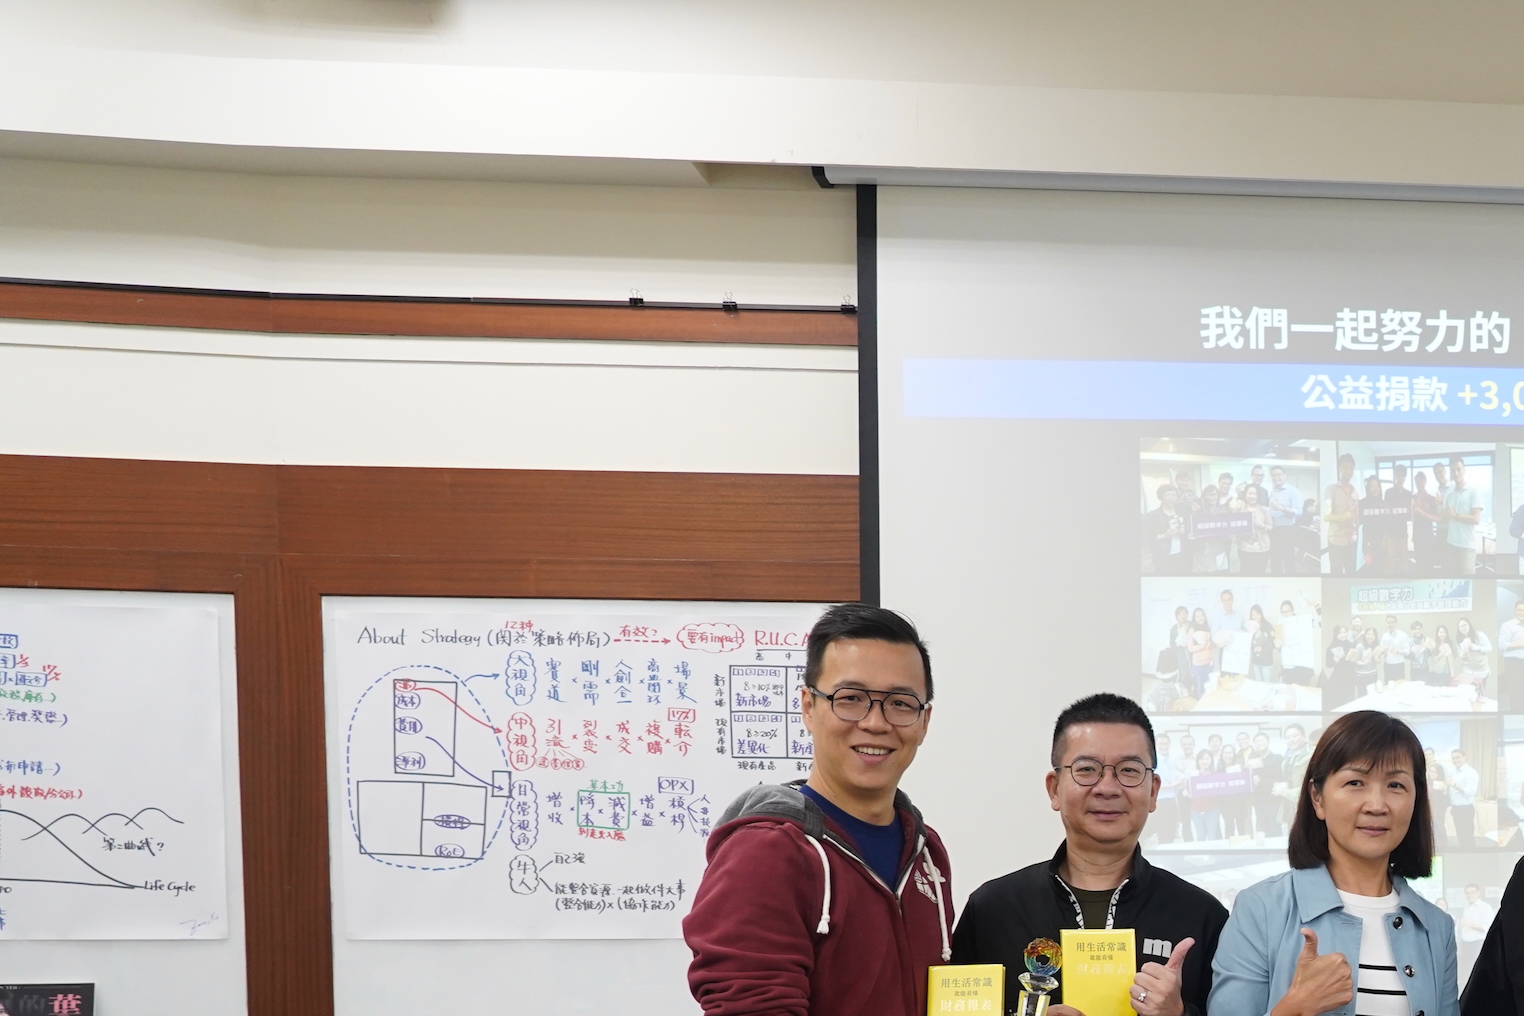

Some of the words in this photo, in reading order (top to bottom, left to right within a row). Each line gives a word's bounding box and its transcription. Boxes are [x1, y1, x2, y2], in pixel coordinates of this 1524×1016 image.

[1200, 305, 1511, 355] 我們一起努力的
[1301, 374, 1449, 412] 公益捐款
[357, 626, 406, 646] About
[421, 627, 481, 647] Strategy
[143, 879, 165, 891] Life
[167, 881, 196, 897] Cycle
[1076, 942, 1127, 952] 用生活常識
[941, 978, 993, 989] 用生活常識
[940, 999, 992, 1012] 財務報表
